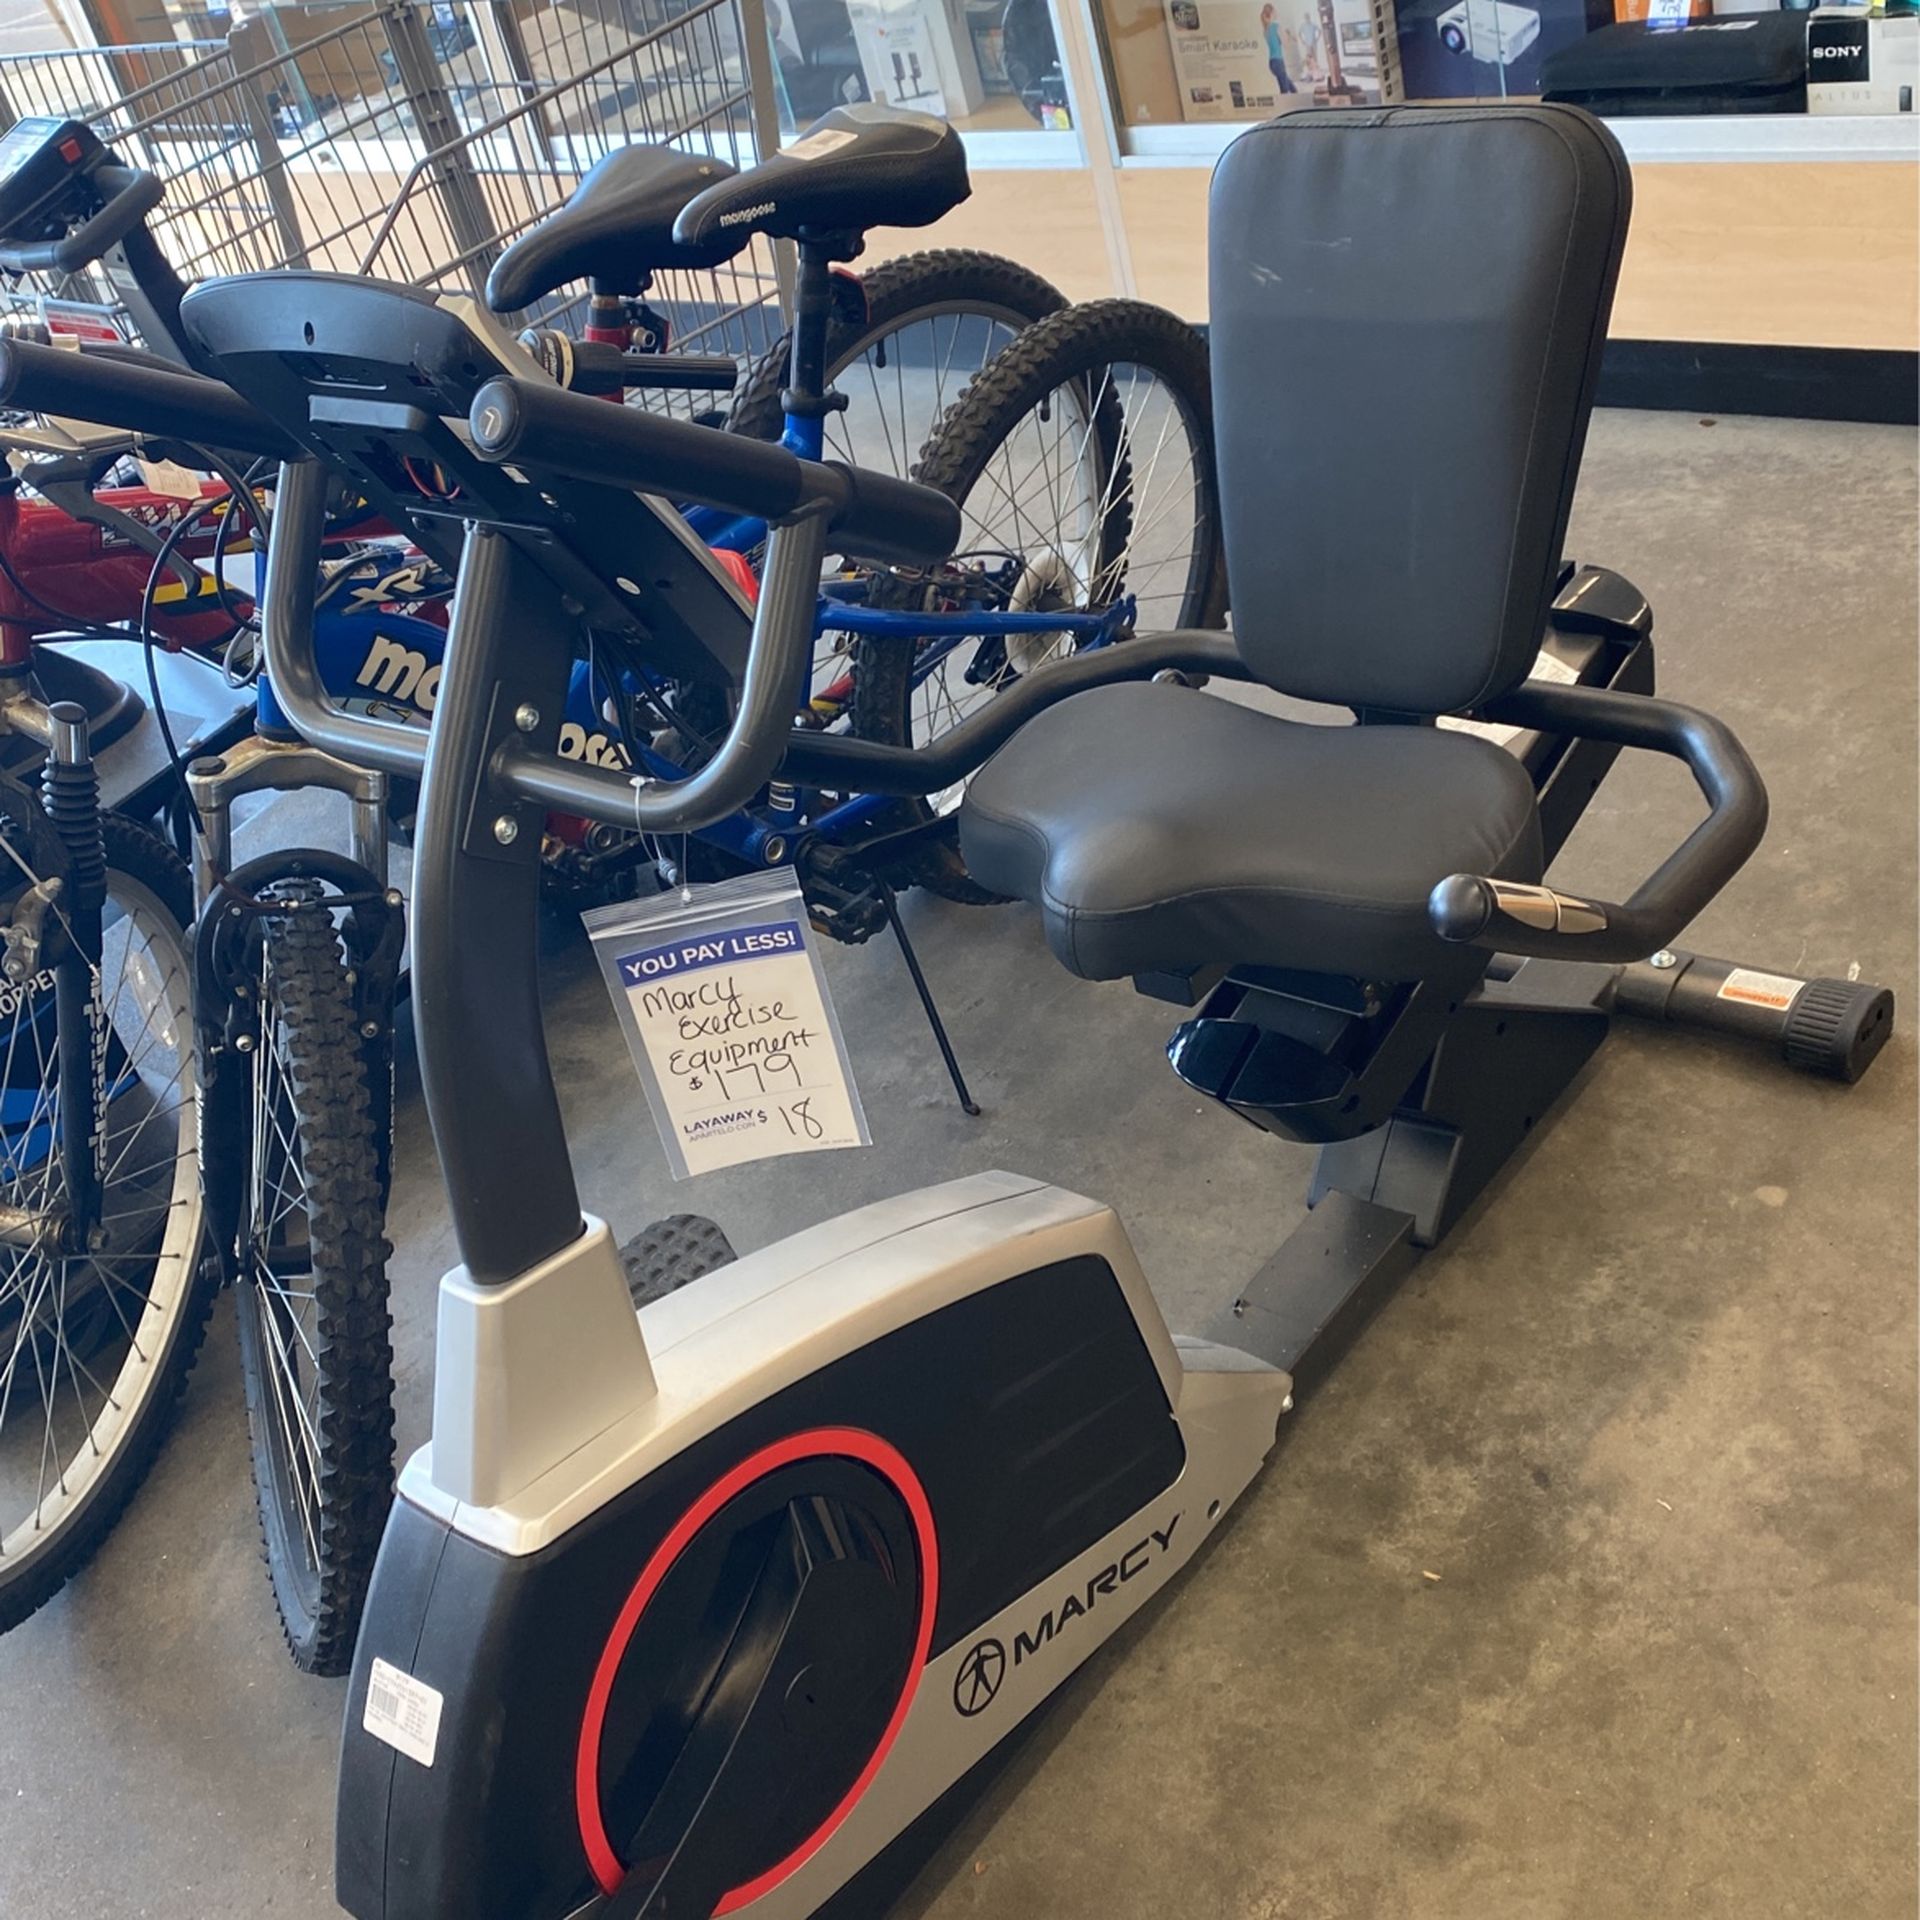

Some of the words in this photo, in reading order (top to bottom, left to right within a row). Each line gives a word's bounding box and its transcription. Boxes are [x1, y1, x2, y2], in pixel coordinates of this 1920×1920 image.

[1213, 40, 1258, 51] Karaoke
[1812, 45, 1862, 58] SONY
[719, 201, 777, 227] mongoose
[625, 952, 678, 979] YOU
[682, 941, 725, 965] PAY
[731, 930, 797, 954] LESS!
[642, 976, 743, 1018] Marcy
[679, 1001, 798, 1041] Exercise
[669, 1028, 820, 1076] Equipment
[688, 1053, 802, 1101] $179
[683, 1109, 753, 1134] LAYAWAY
[778, 1096, 823, 1139] 18
[736, 1121, 756, 1132] CON
[1014, 1512, 1181, 1667] MARCY
